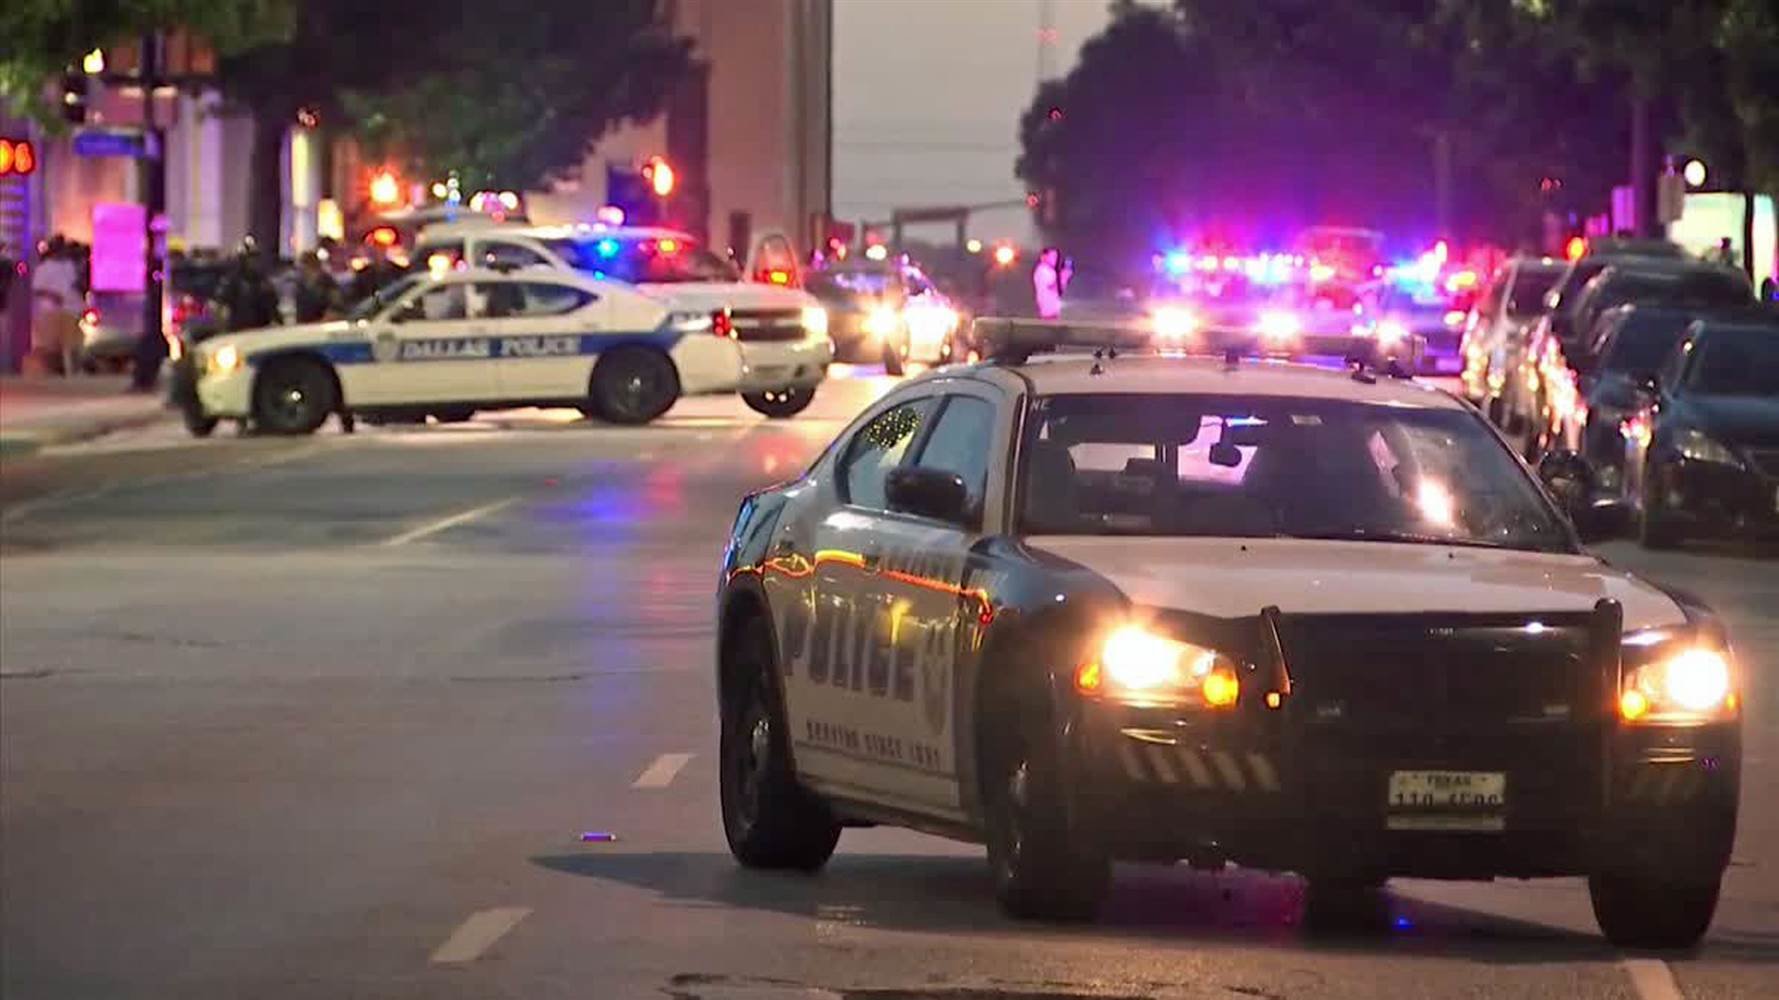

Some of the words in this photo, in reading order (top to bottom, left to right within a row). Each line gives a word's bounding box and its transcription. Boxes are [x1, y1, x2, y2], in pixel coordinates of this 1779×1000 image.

[402, 338, 490, 359] DALLAS
[500, 334, 580, 356] POLICE
[781, 604, 915, 702] POLICE
[864, 733, 903, 759] SINCE
